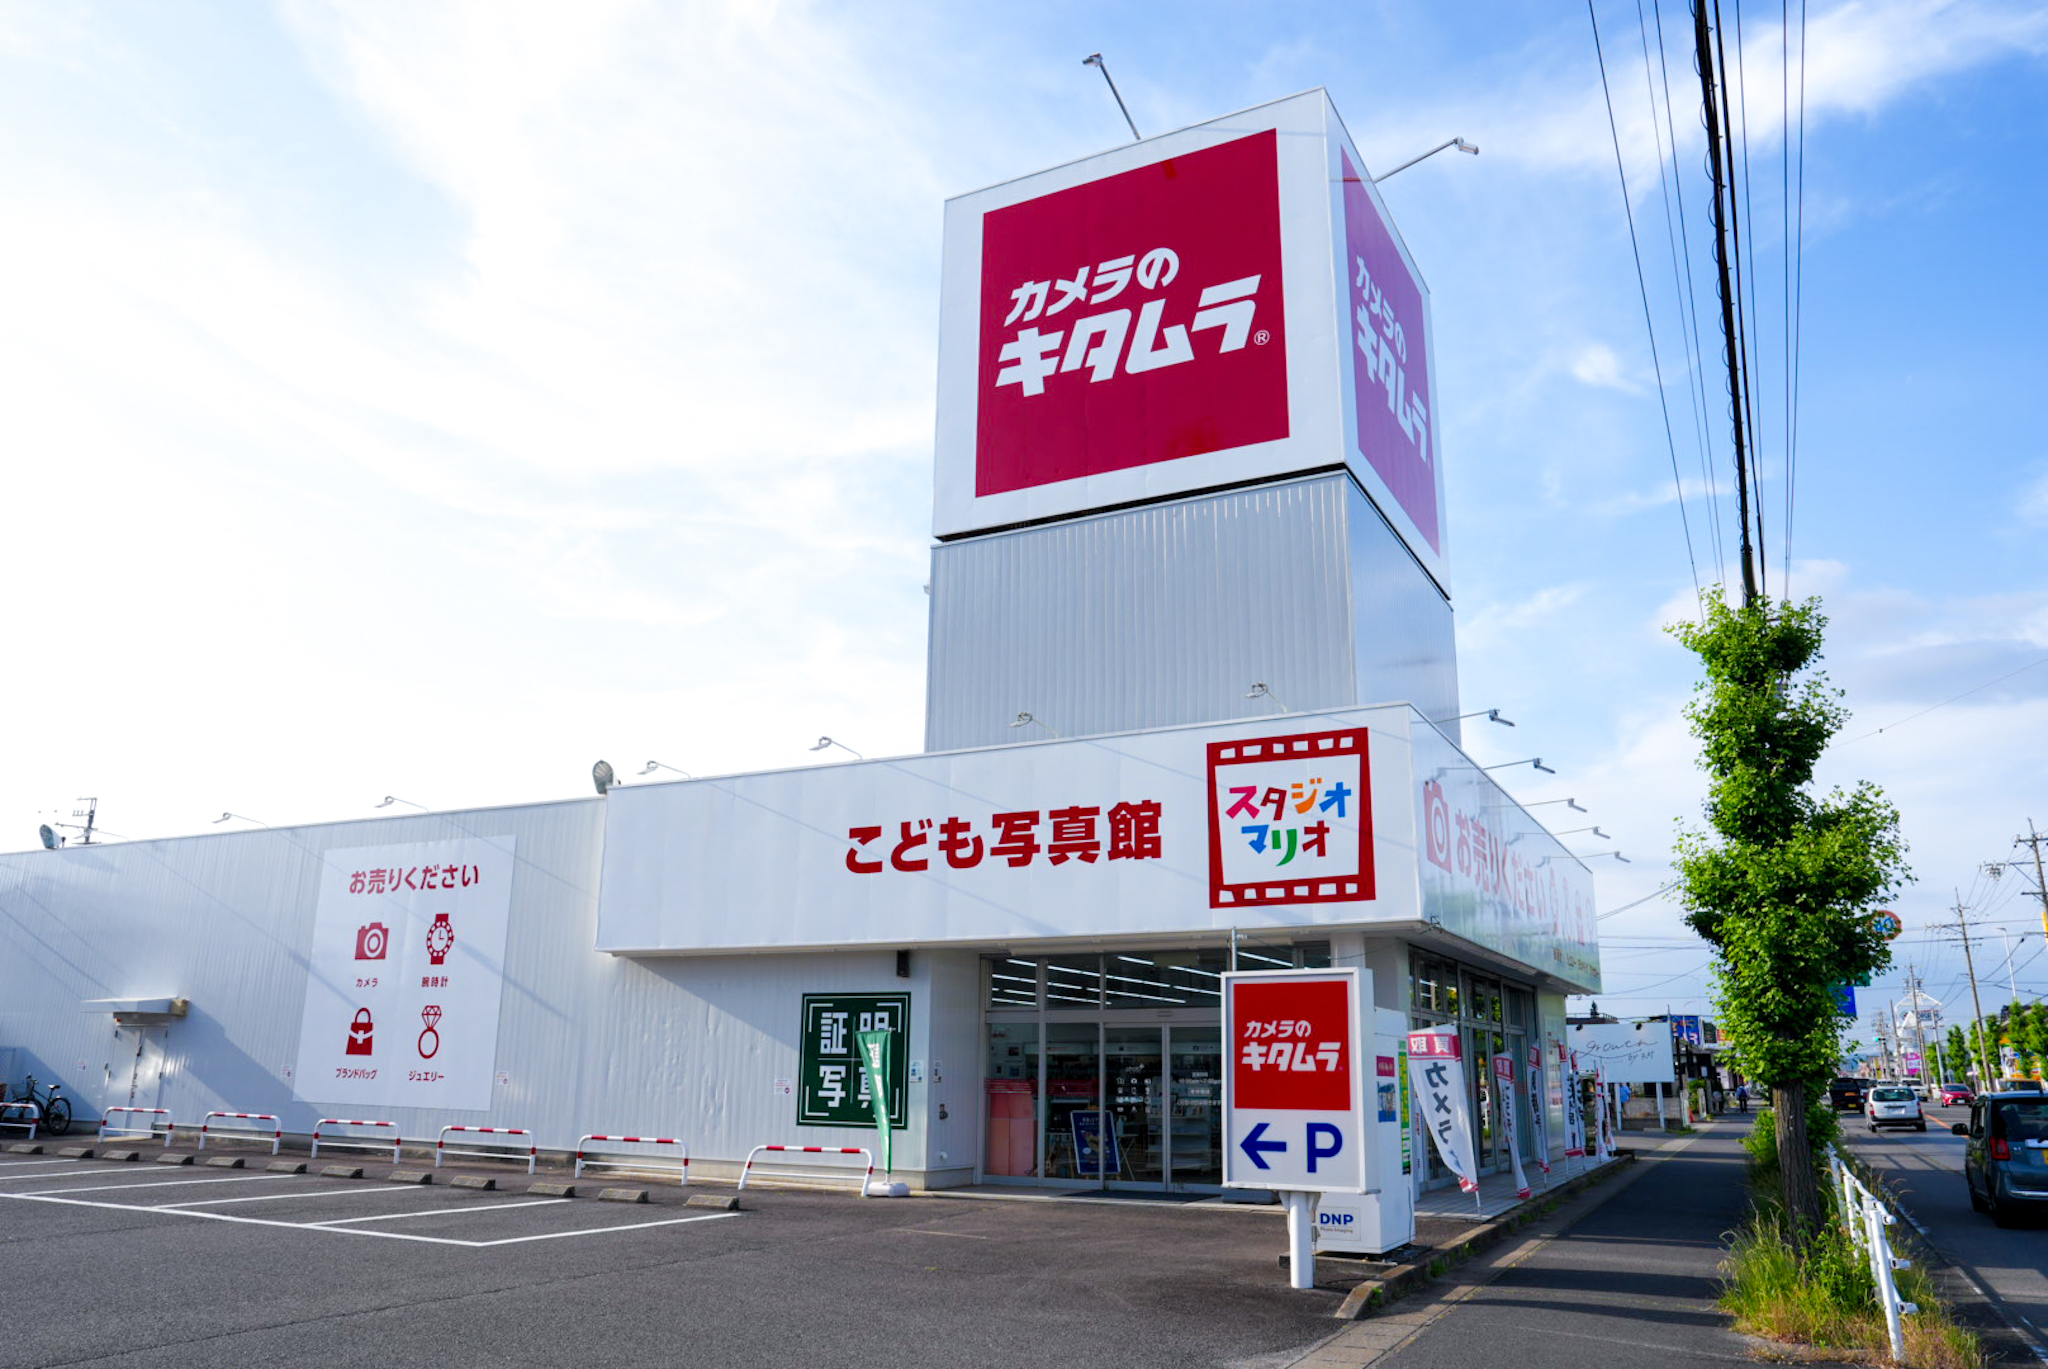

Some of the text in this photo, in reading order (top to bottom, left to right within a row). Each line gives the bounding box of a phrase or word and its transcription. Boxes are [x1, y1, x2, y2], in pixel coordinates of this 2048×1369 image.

[1003, 247, 1180, 327] カメラの
[1356, 254, 1408, 365] カメラの
[1356, 303, 1428, 465] キタムラ
[1225, 777, 1352, 821] スタジオ
[845, 799, 1163, 874] こども写真館
[1241, 820, 1331, 867] マリオ
[349, 864, 480, 894] お売りください
[355, 977, 379, 988] カメラ
[1243, 1020, 1312, 1038] カメラの
[335, 1067, 378, 1080] ブランドバッグ
[1241, 1041, 1341, 1072] キタムラ
[408, 1070, 444, 1082] ジュエリー
[1306, 1122, 1343, 1173] P
[1320, 1213, 1354, 1225] DNP
